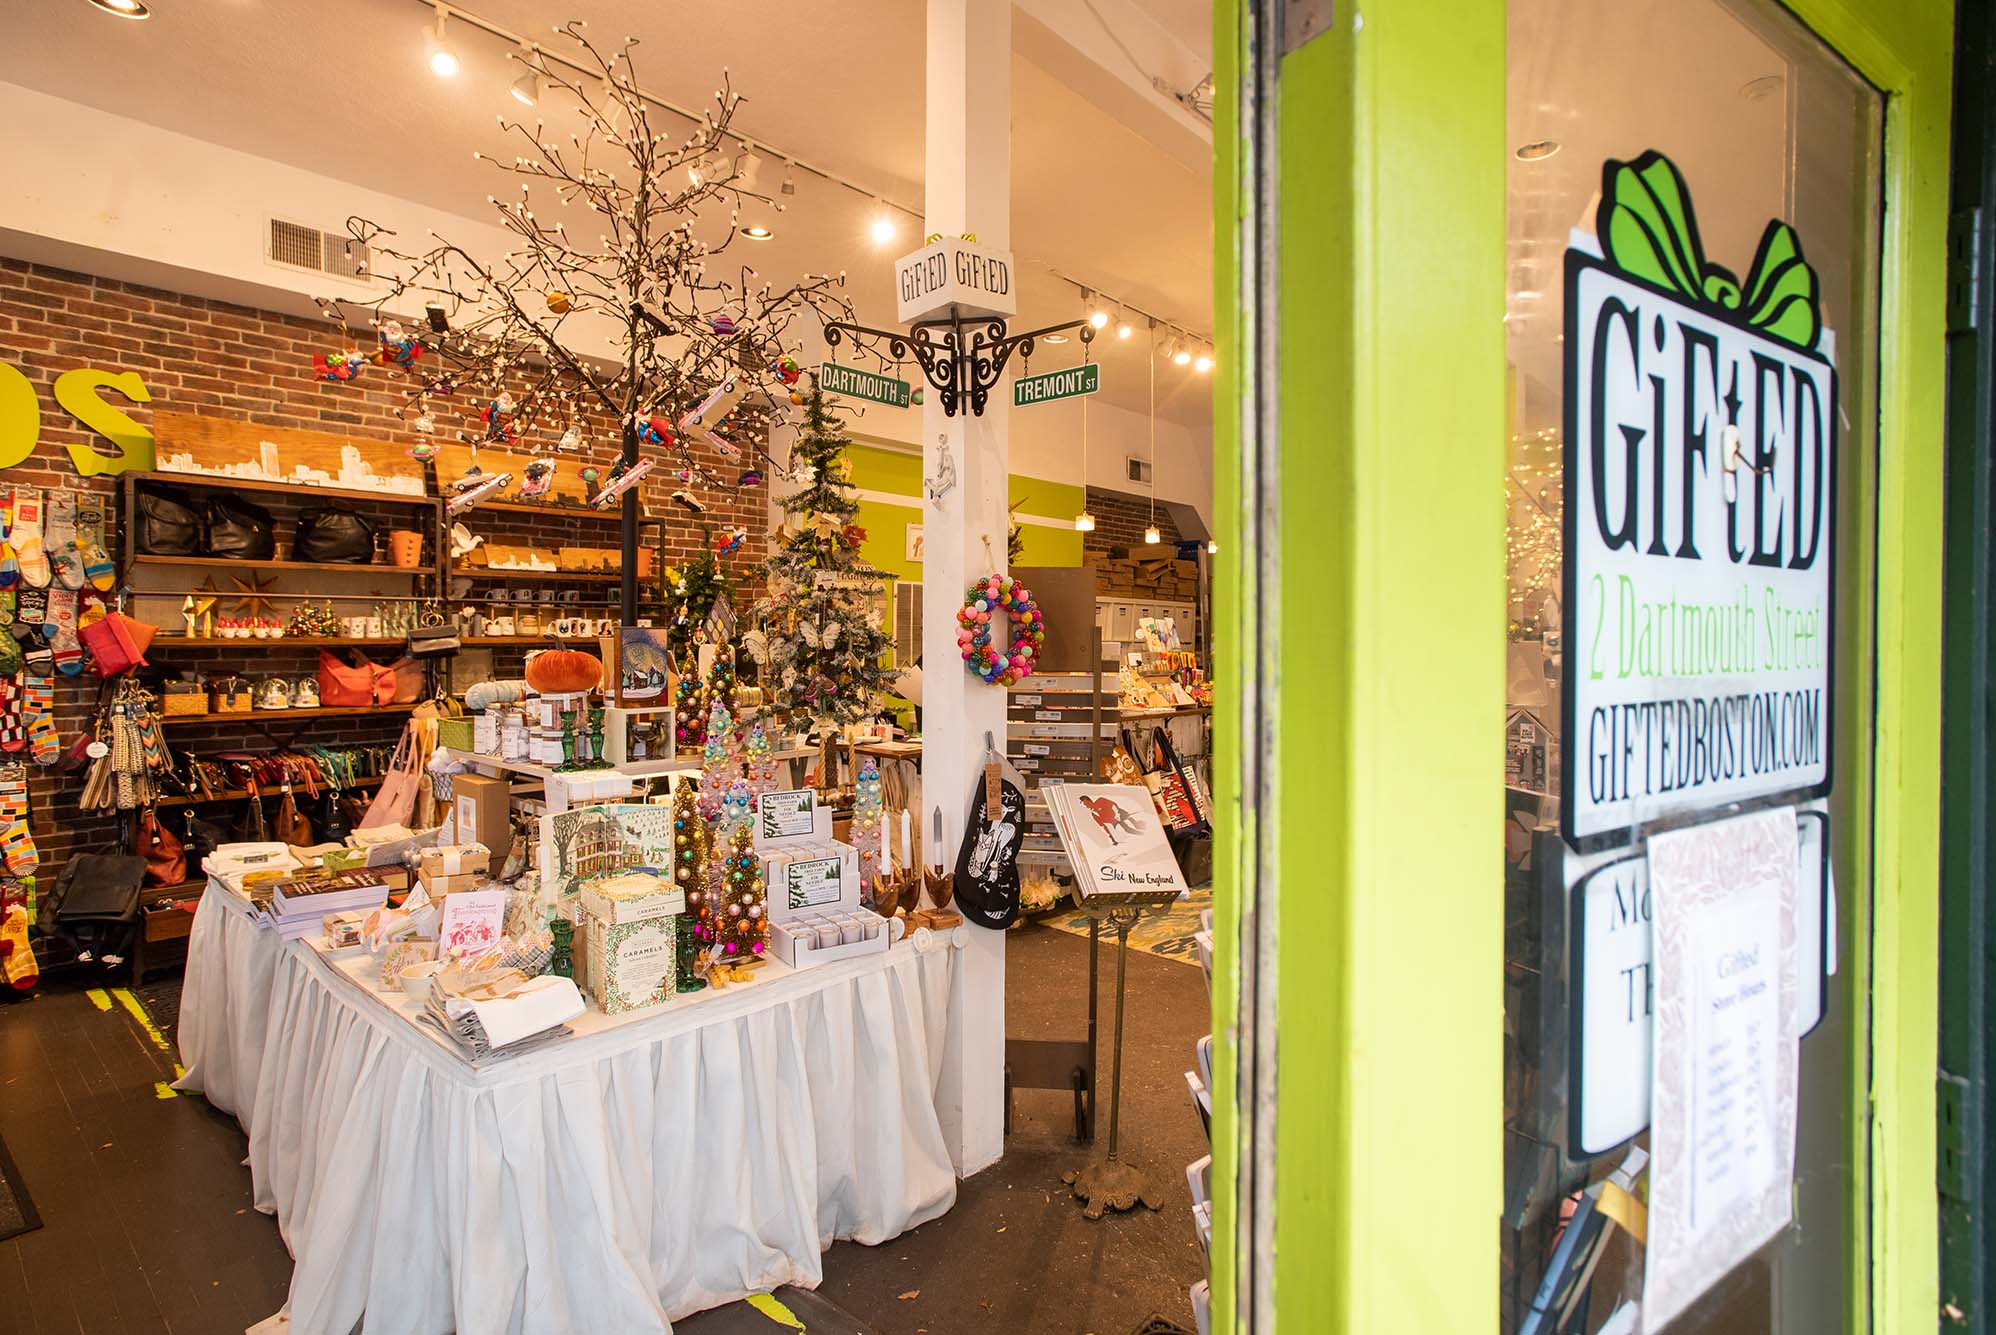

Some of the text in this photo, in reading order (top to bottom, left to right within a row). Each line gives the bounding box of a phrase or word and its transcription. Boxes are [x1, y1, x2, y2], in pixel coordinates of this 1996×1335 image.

[823, 365, 909, 405] DARTMOUTH ST
[1016, 370, 1096, 404] TREMONT ST
[1590, 572, 1822, 681] 2 Dartmouth Street
[1588, 687, 1822, 806] GIFTEDBOSTON.COM
[800, 861, 830, 870] BEDROCK
[1100, 865, 1175, 887] Ski New England
[637, 905, 666, 916] CARAMELS
[623, 945, 663, 959] CARAMELS
